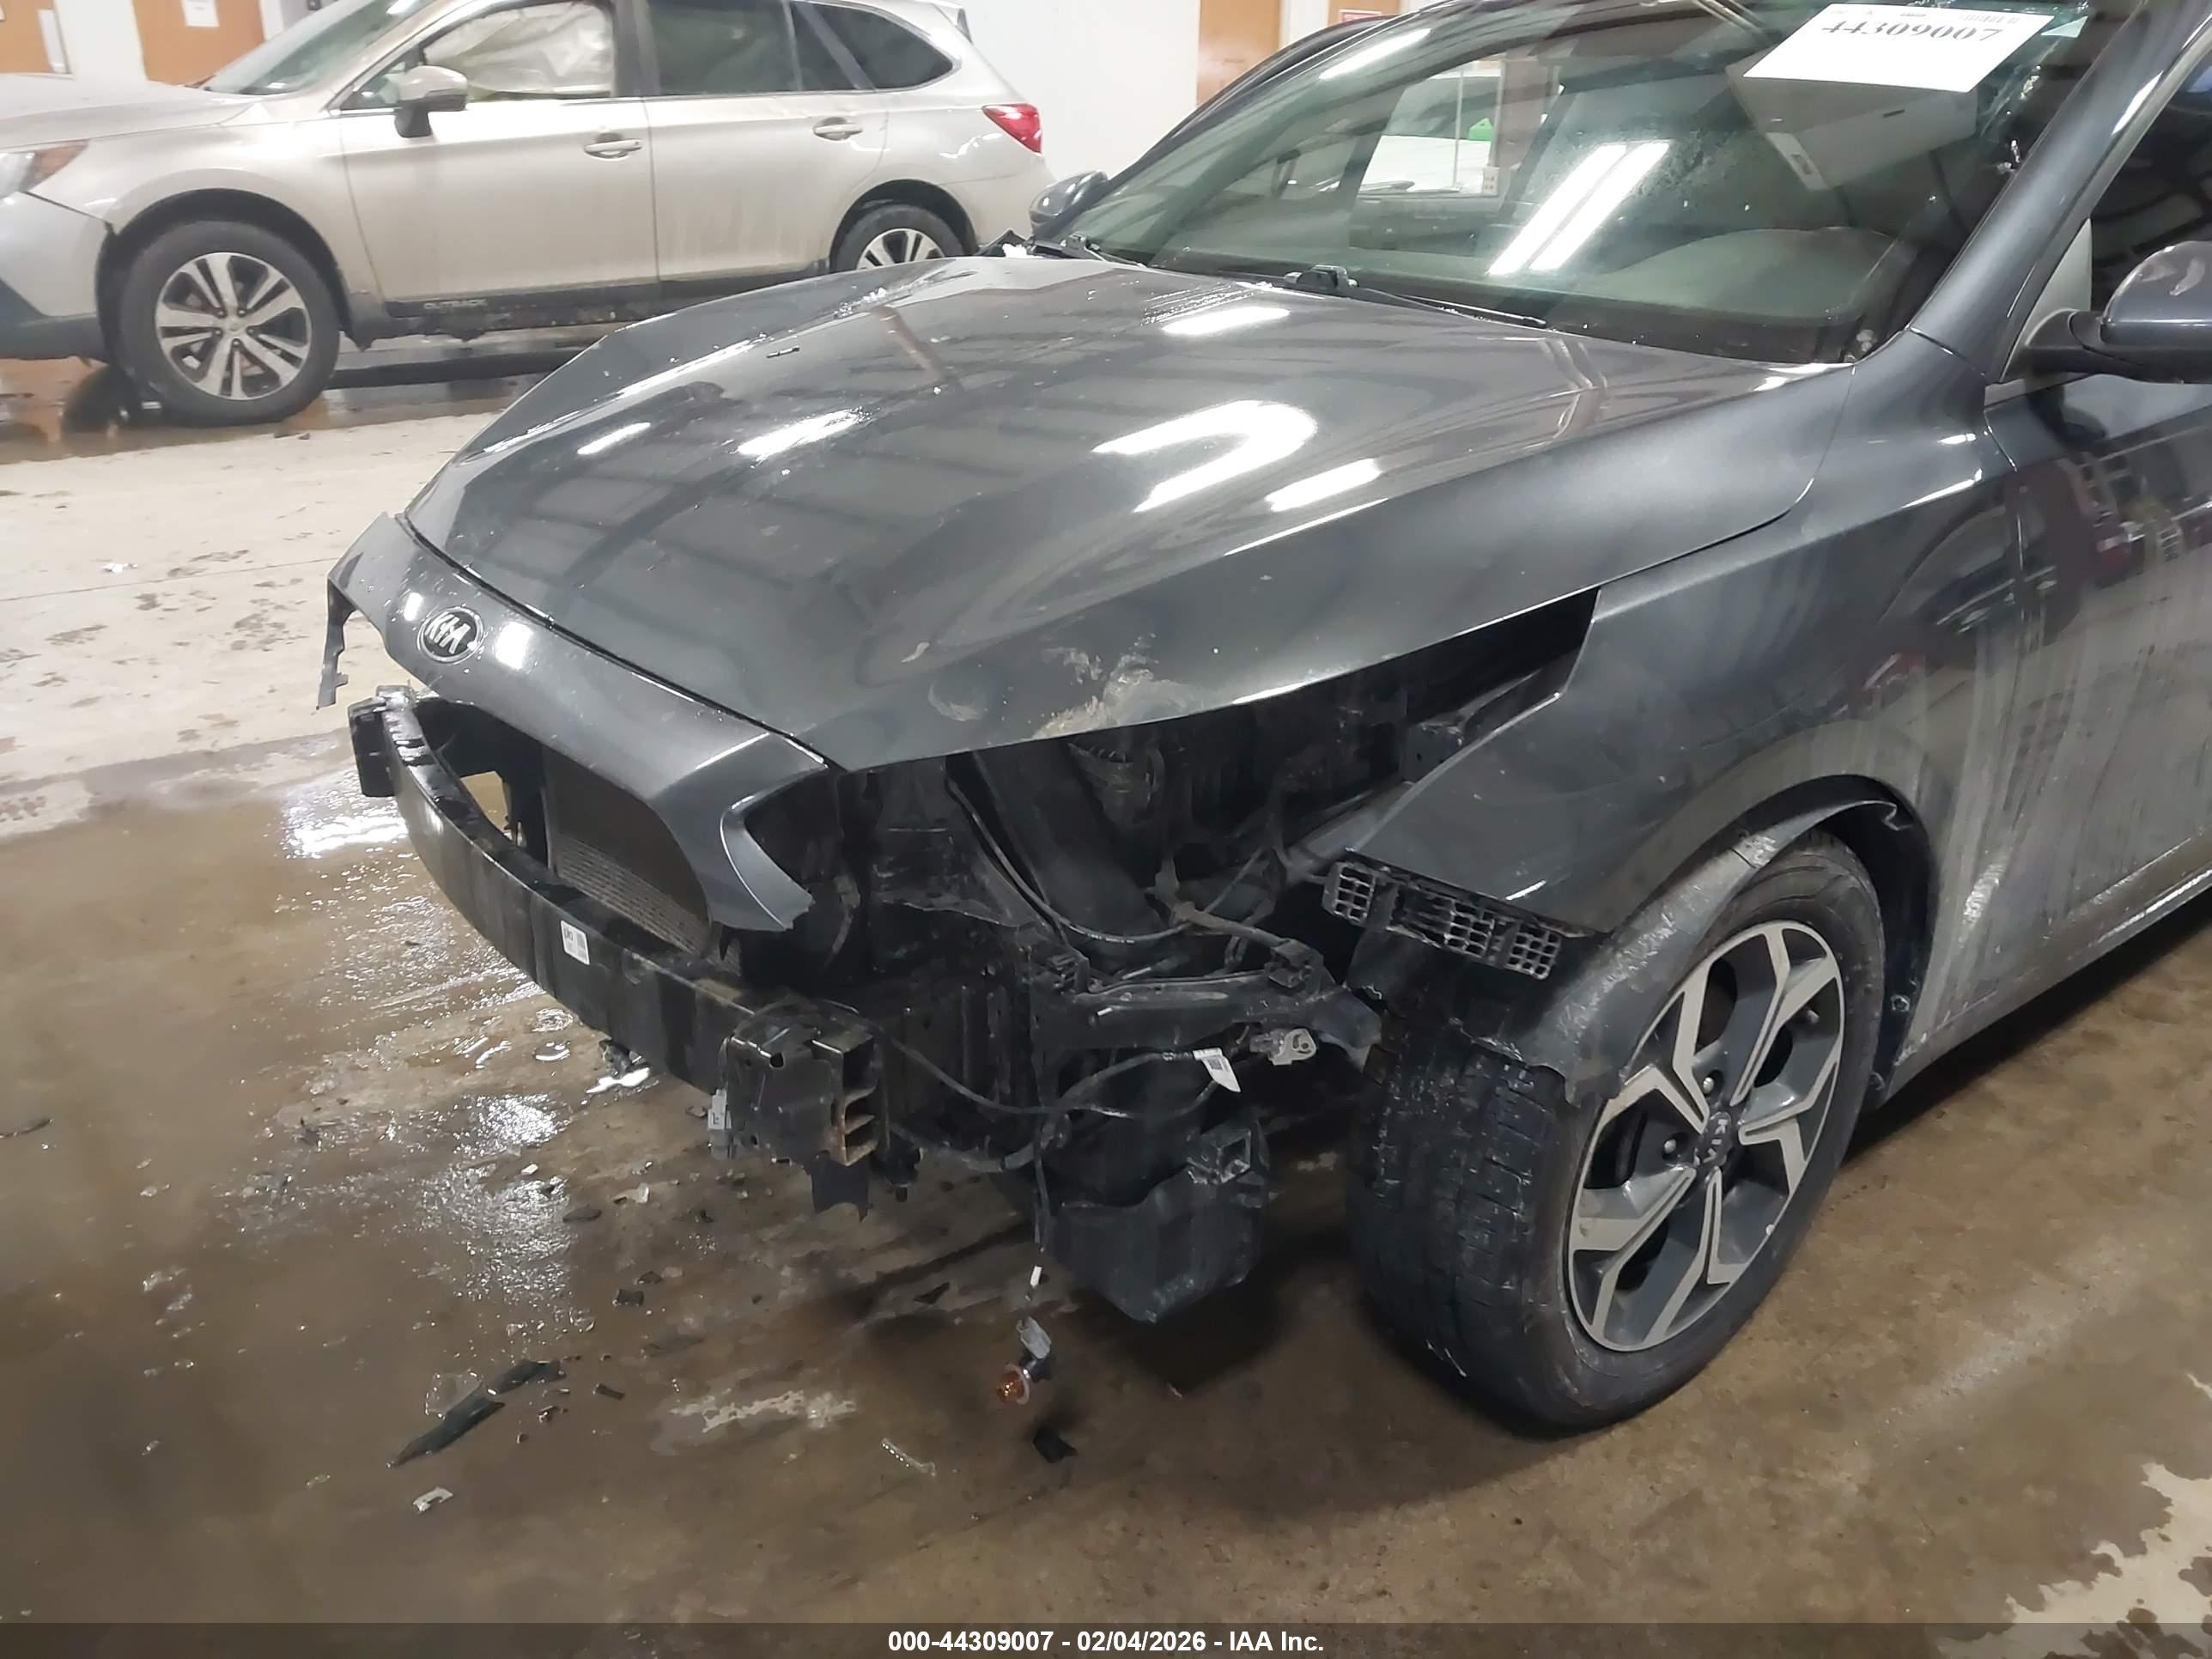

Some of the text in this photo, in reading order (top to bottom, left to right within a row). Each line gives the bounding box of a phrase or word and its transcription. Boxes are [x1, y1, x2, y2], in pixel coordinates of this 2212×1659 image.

[1821, 20, 2004, 41] 44309007
[423, 611, 471, 655] KIA
[1702, 1118, 1729, 1164] KIA
